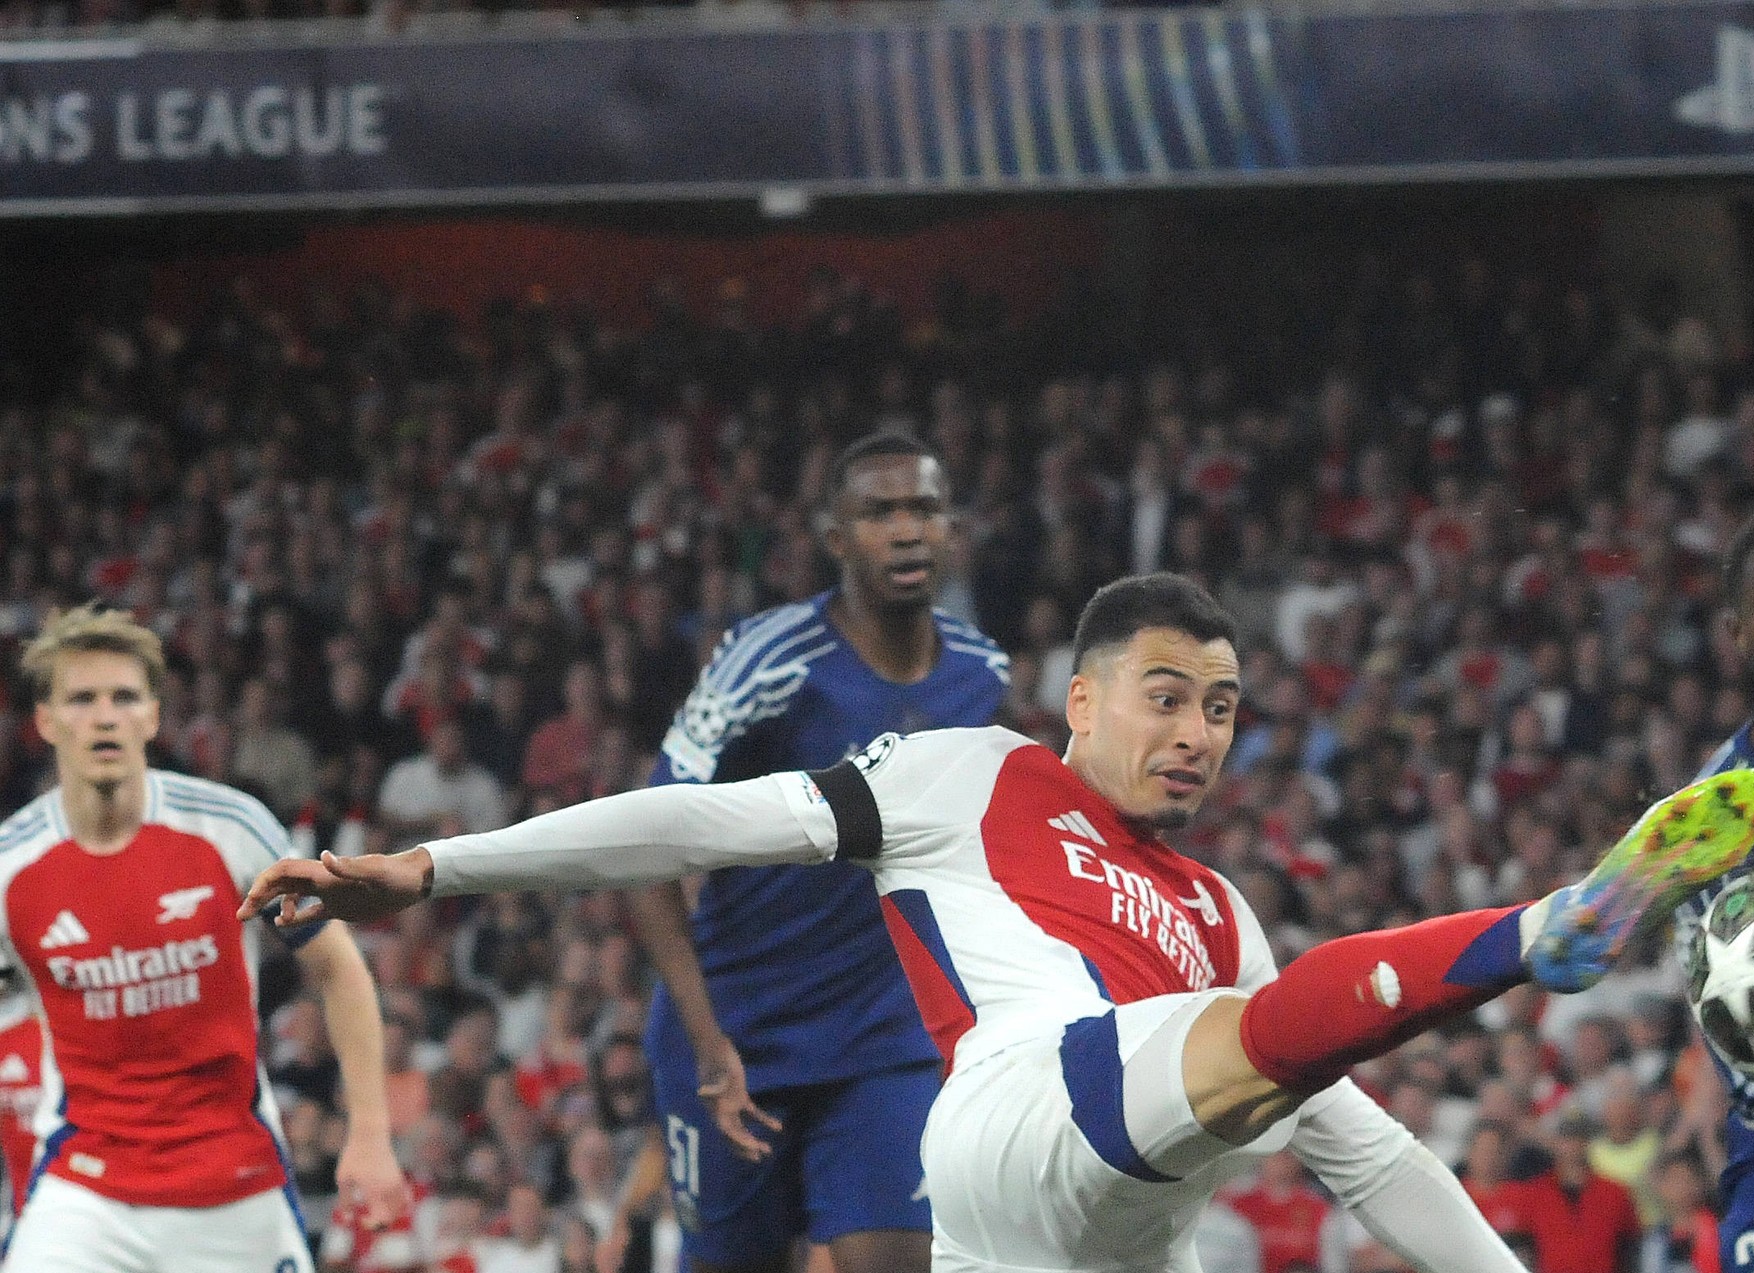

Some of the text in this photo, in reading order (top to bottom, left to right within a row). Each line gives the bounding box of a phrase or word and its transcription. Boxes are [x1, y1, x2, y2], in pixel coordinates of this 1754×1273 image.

[0, 85, 388, 161] NS LEAGUE
[1112, 891, 1151, 938] FLY
[47, 934, 218, 990] Emirates
